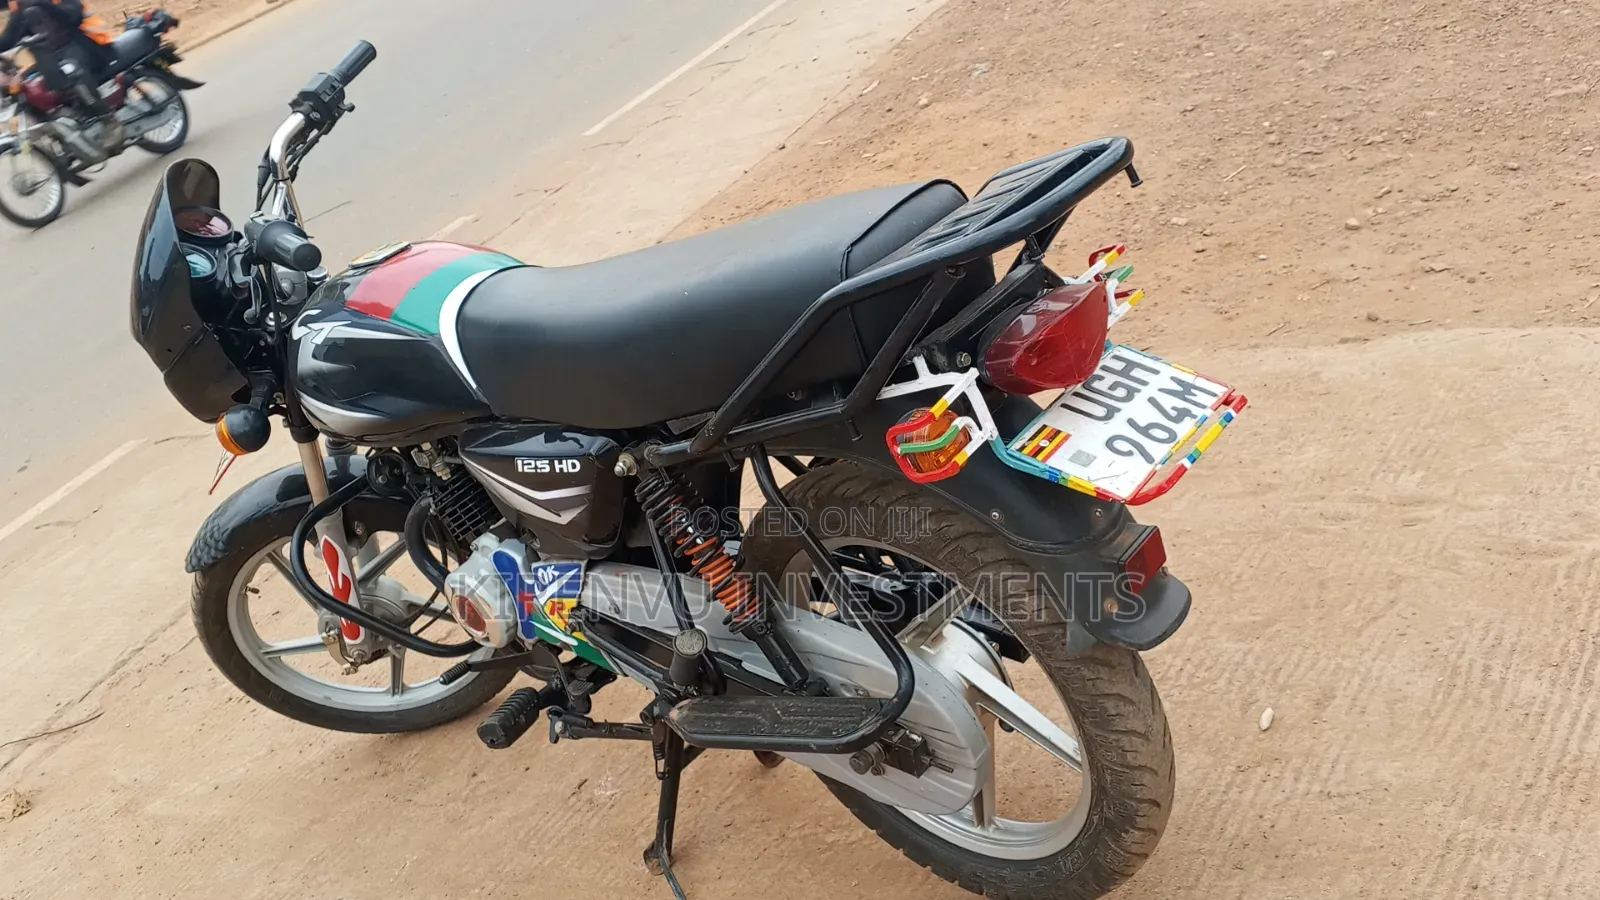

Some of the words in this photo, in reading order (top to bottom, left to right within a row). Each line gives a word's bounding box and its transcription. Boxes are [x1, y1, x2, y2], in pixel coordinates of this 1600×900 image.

[1060, 354, 1161, 422] UGH
[1105, 376, 1218, 465] 964M
[516, 459, 551, 473] 125
[553, 459, 581, 473] HD
